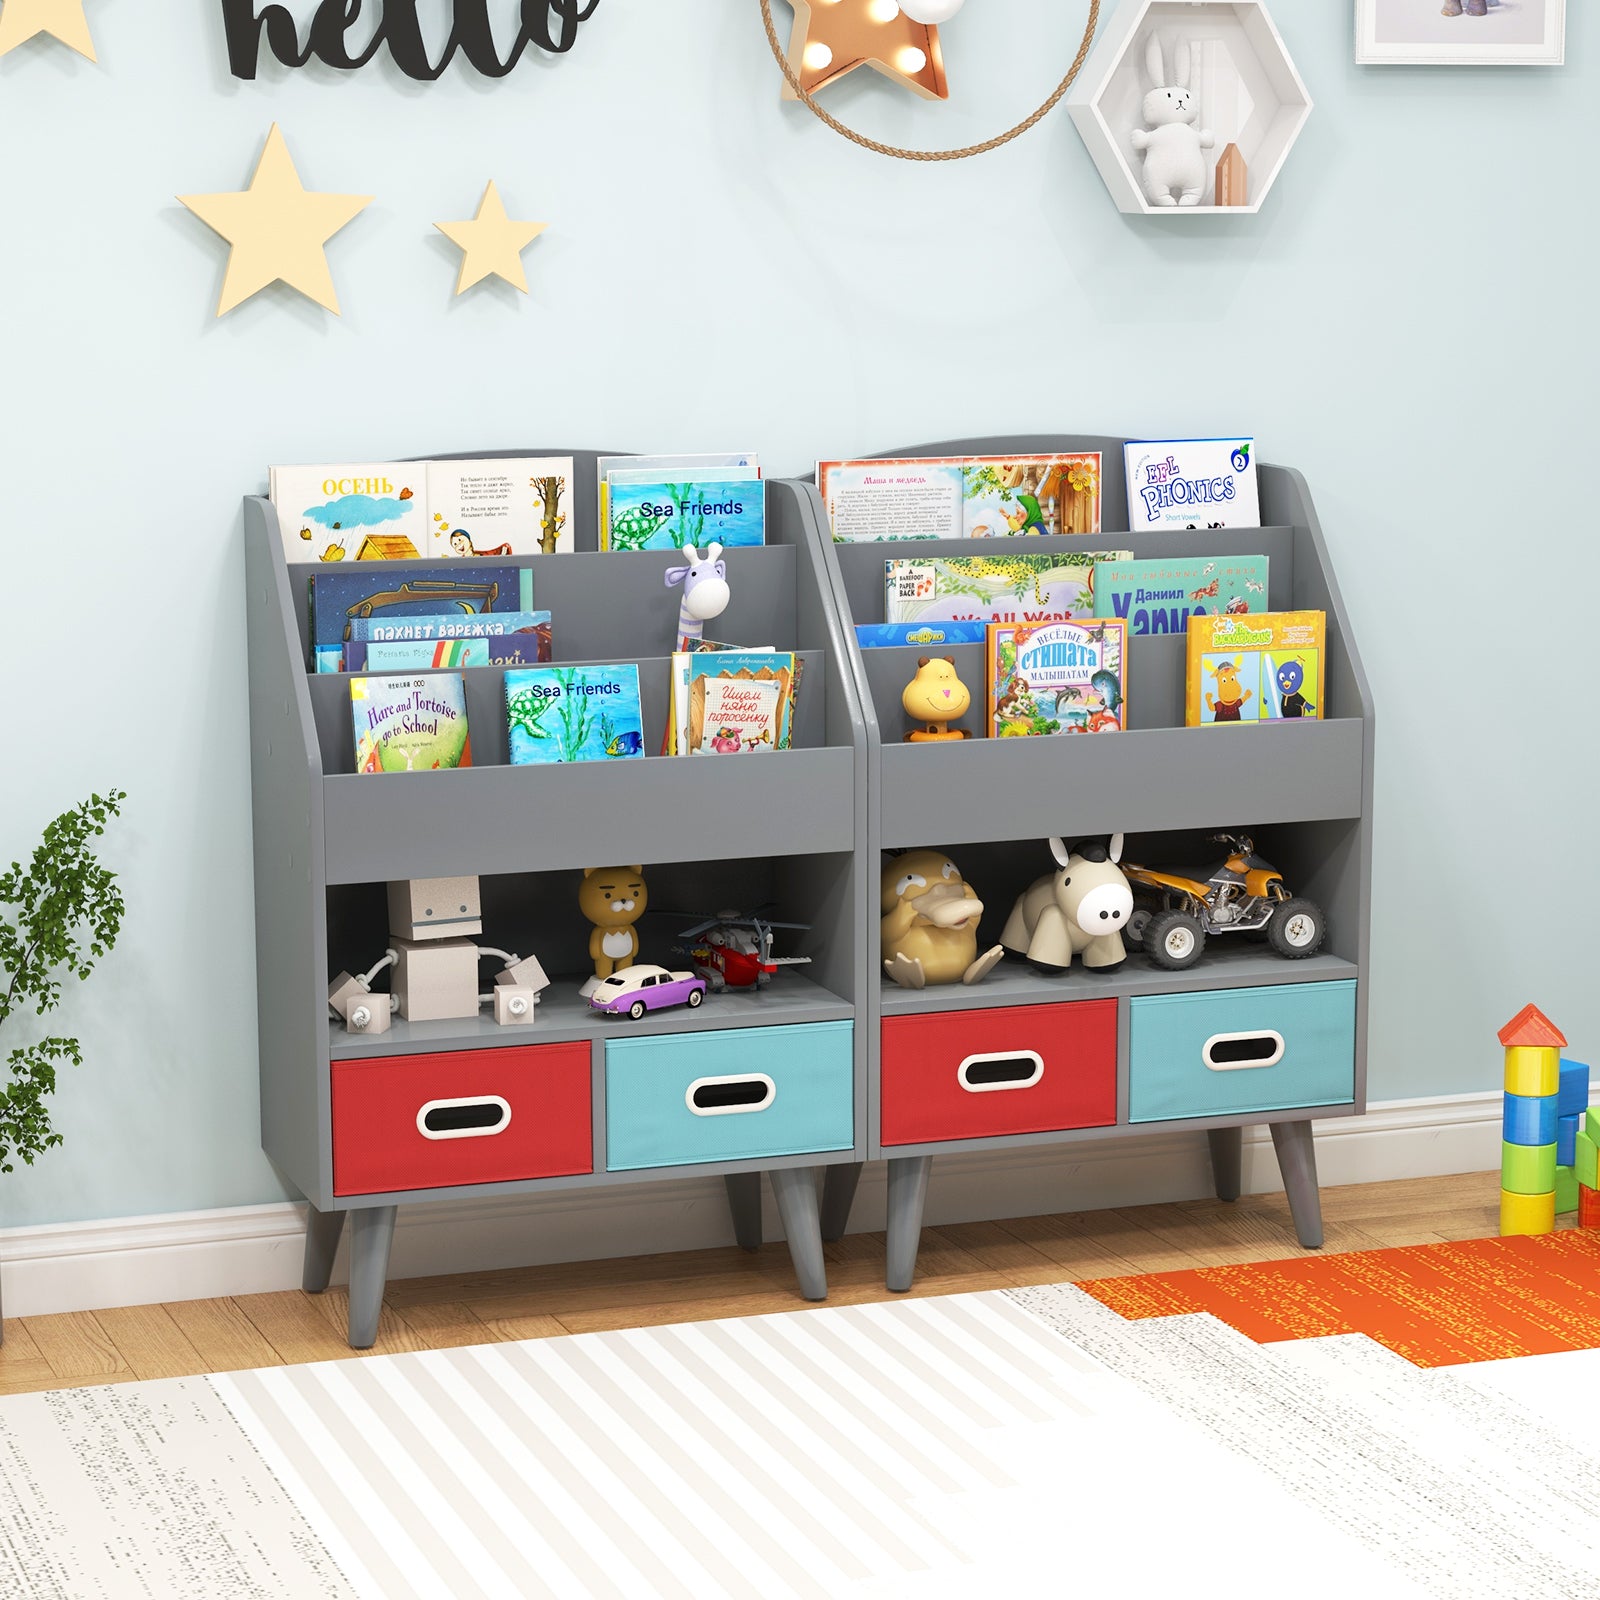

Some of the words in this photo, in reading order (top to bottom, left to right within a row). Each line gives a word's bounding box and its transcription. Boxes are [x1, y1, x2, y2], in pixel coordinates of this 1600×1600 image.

[1146, 455, 1180, 484] EFL
[1236, 456, 1243, 467] 2
[322, 477, 394, 495] ОСЕНЬ
[1140, 475, 1235, 521] PHONICS
[641, 502, 674, 518] Sea
[680, 499, 743, 516] Friends
[1165, 513, 1181, 521] Short
[1181, 513, 1201, 521] Vowels
[899, 589, 915, 597] BACK
[1135, 588, 1184, 604] Даниил
[1037, 628, 1082, 646] ВЕСЁЛЫЕ
[1030, 669, 1089, 681] МАЛЫШАТАМ
[532, 684, 561, 698] Sea
[566, 681, 621, 696] Friends
[721, 685, 762, 701] Ищем
[367, 705, 394, 730] Hare
[396, 698, 412, 714] and
[412, 691, 457, 720] Tortoise
[720, 701, 758, 713] няню
[382, 731, 393, 748] go
[393, 725, 402, 737] to
[402, 714, 438, 736] School
